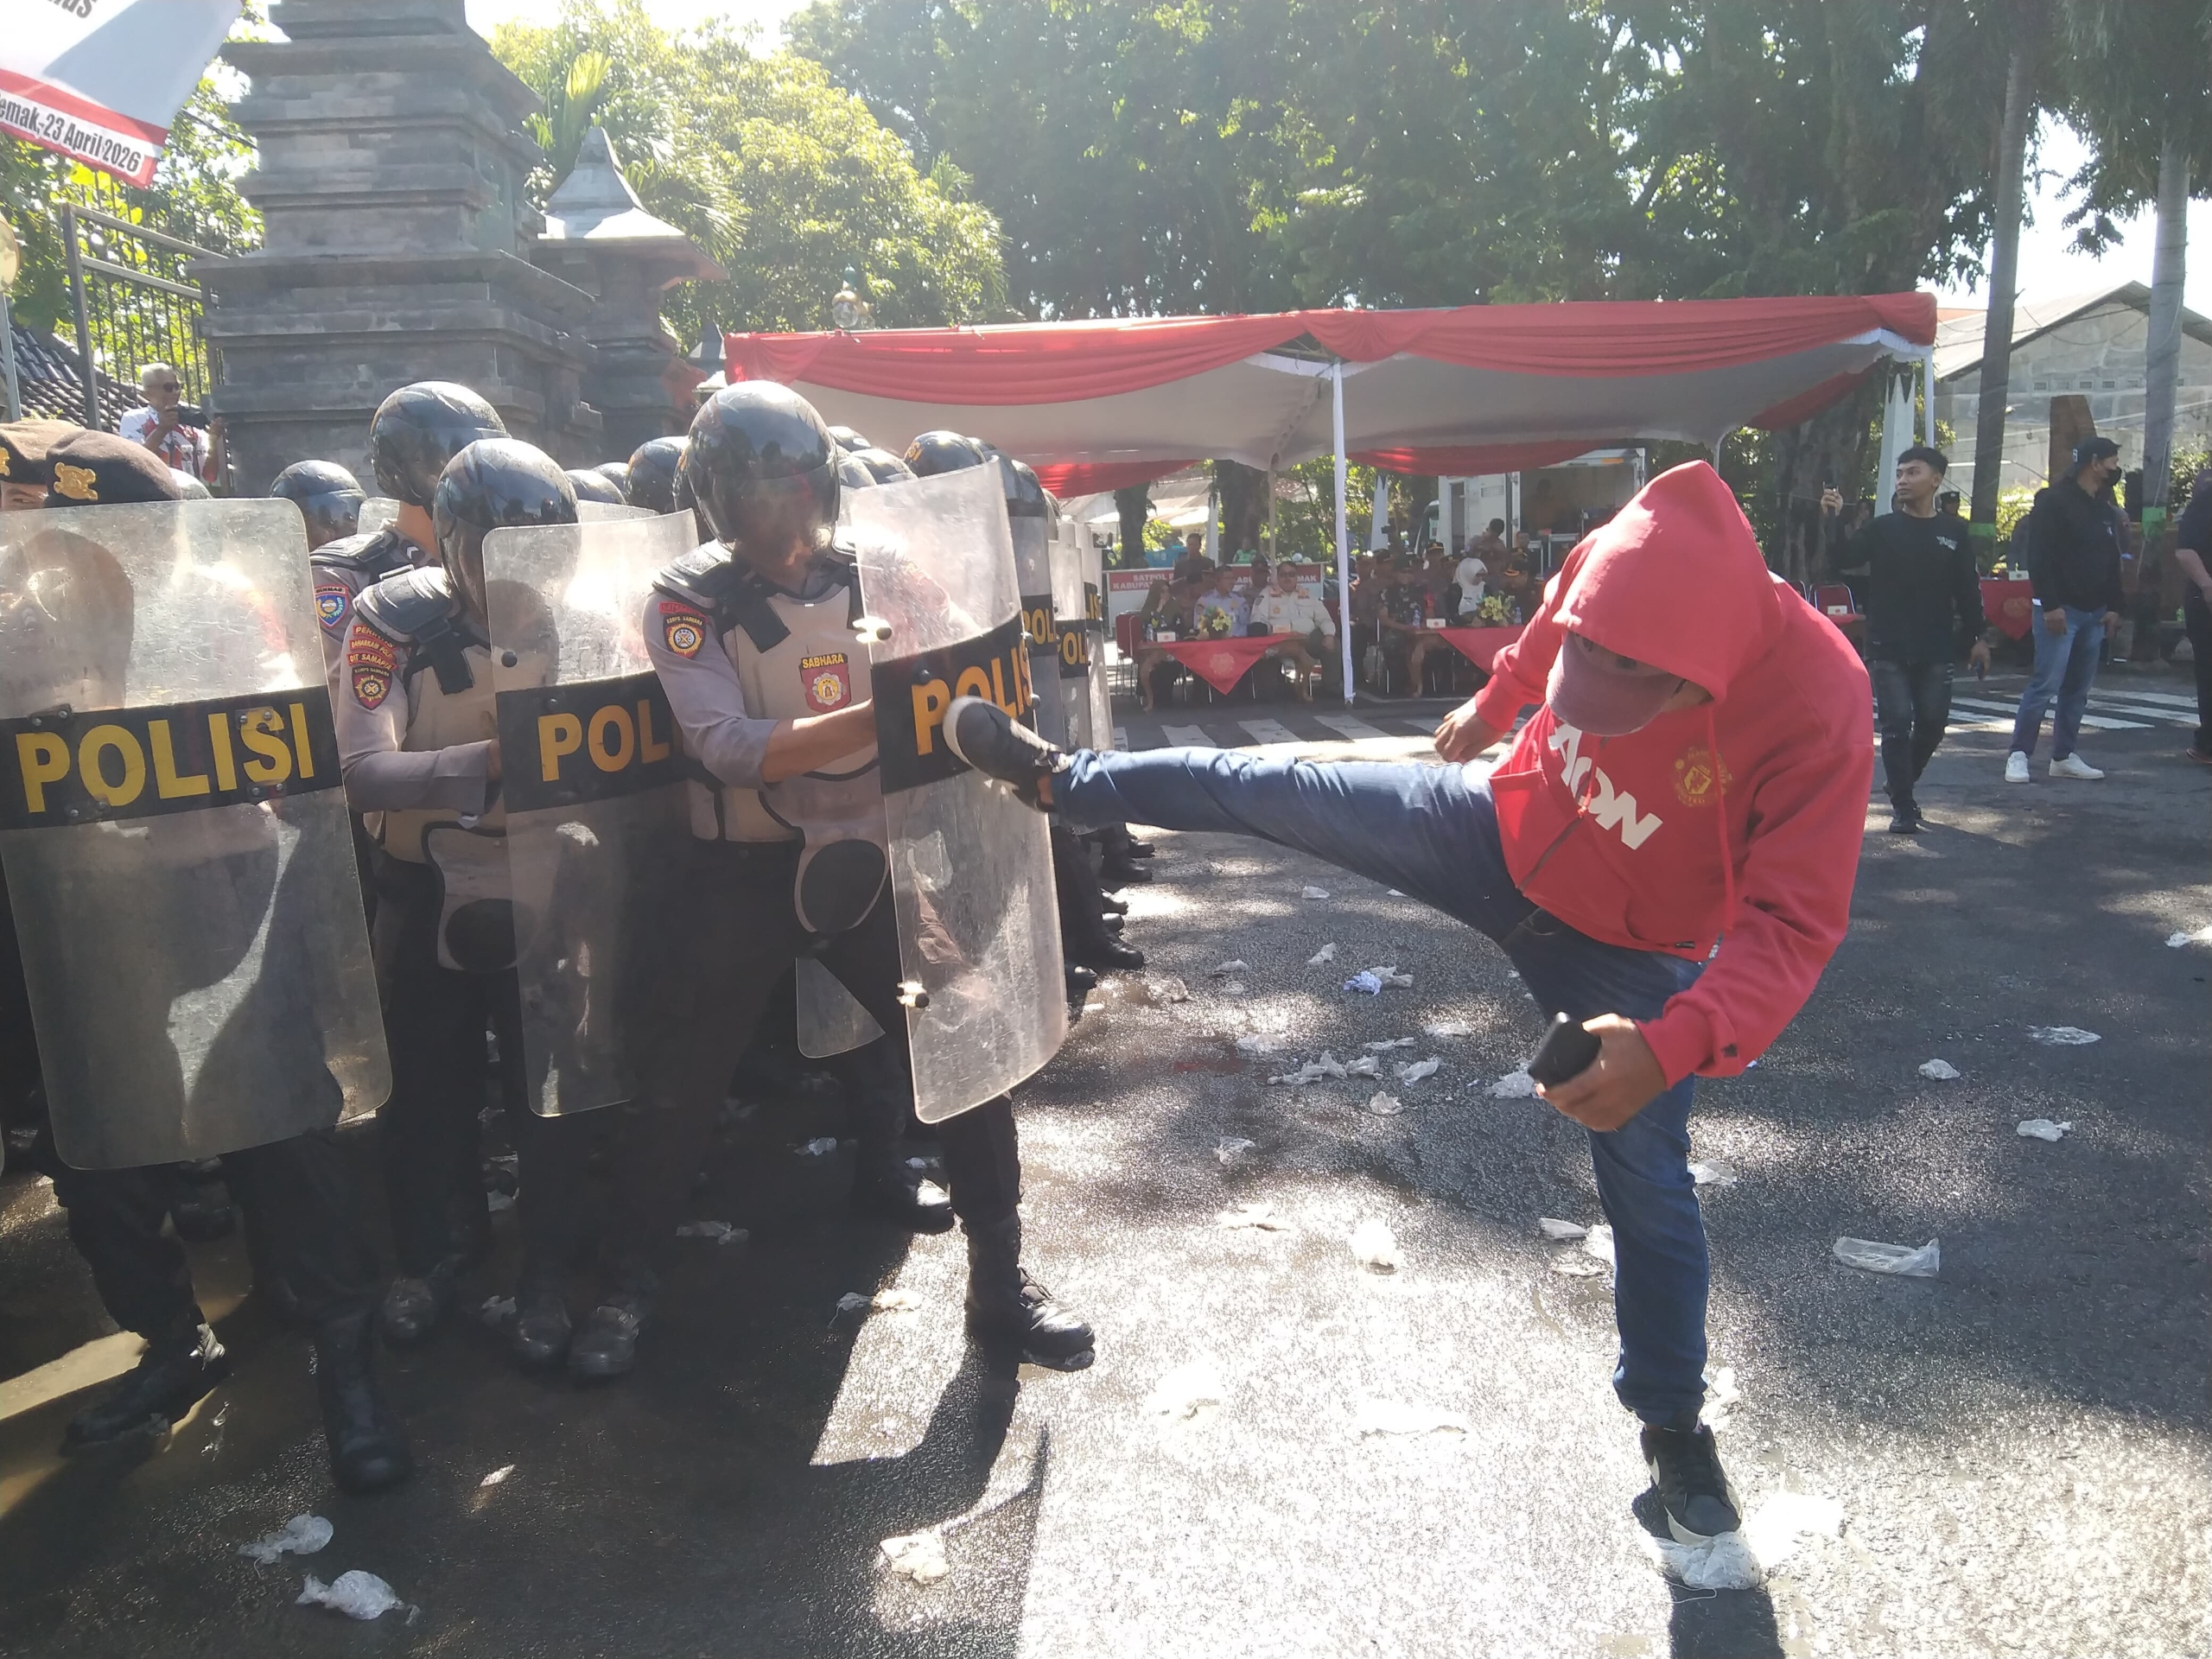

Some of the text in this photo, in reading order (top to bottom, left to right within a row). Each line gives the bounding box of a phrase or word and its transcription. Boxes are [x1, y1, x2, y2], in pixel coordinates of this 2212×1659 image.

[0, 95, 41, 135] emak,
[63, 123, 104, 152] April
[102, 138, 142, 173] 2026
[349, 653, 393, 671] DIT SAMAPTA
[802, 653, 845, 669] SABHARA
[15, 702, 315, 814] POLISI
[1548, 723, 1664, 851] AON
